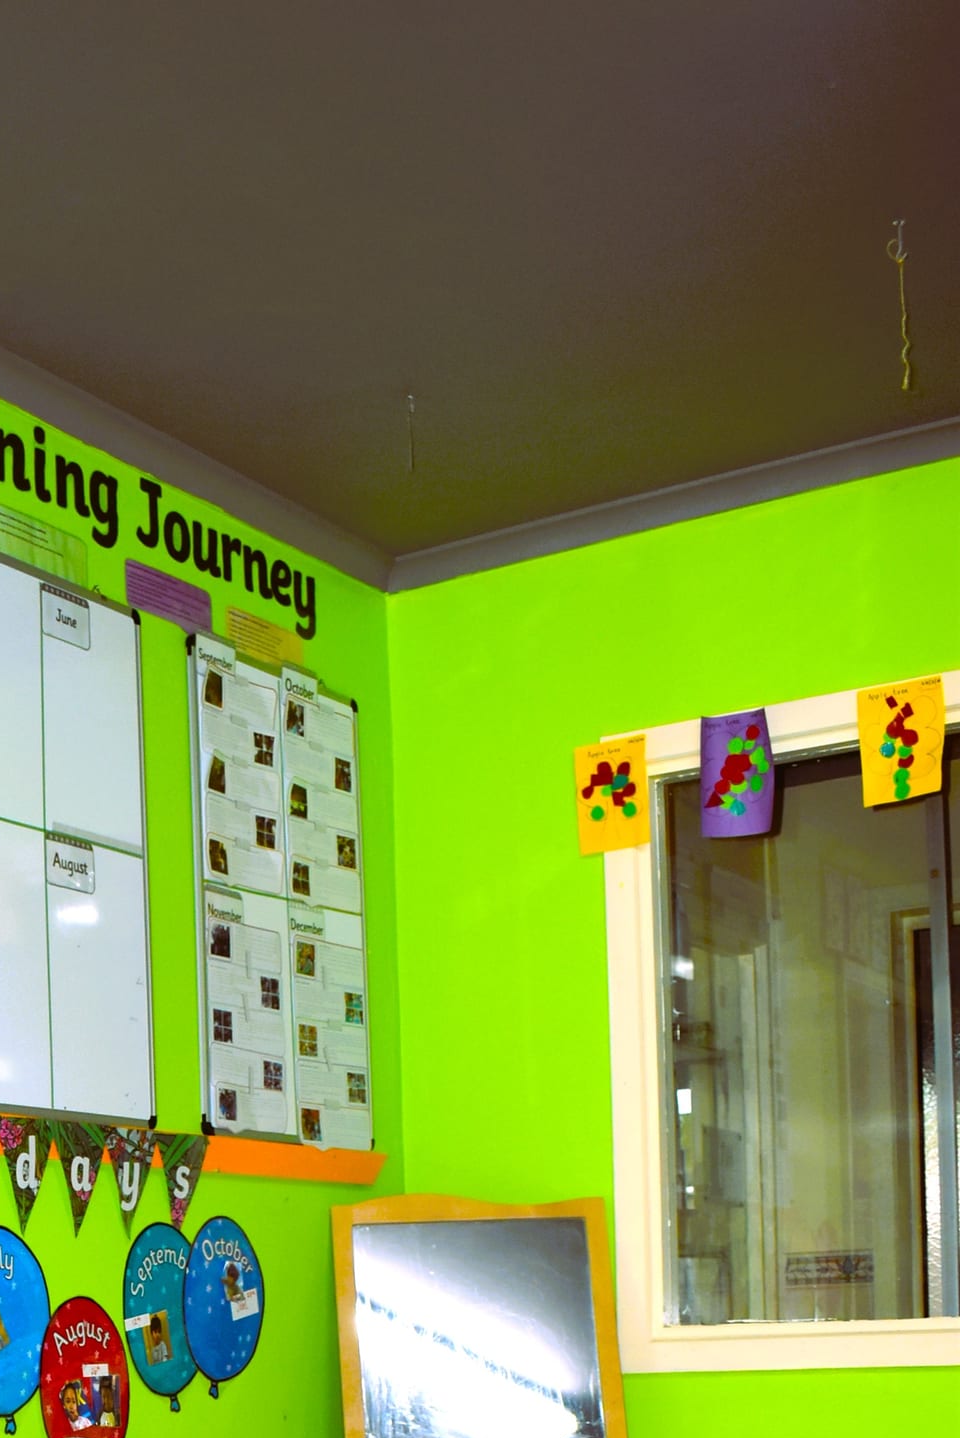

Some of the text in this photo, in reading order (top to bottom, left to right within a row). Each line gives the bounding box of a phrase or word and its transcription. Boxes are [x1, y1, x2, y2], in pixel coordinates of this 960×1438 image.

[136, 477, 315, 640] Journey
[55, 608, 77, 629] June
[198, 648, 233, 671] September
[285, 678, 315, 700] October
[52, 852, 89, 878] August
[207, 903, 242, 924] November
[290, 917, 324, 936] December
[201, 1238, 254, 1273] October
[52, 1319, 111, 1356] August
